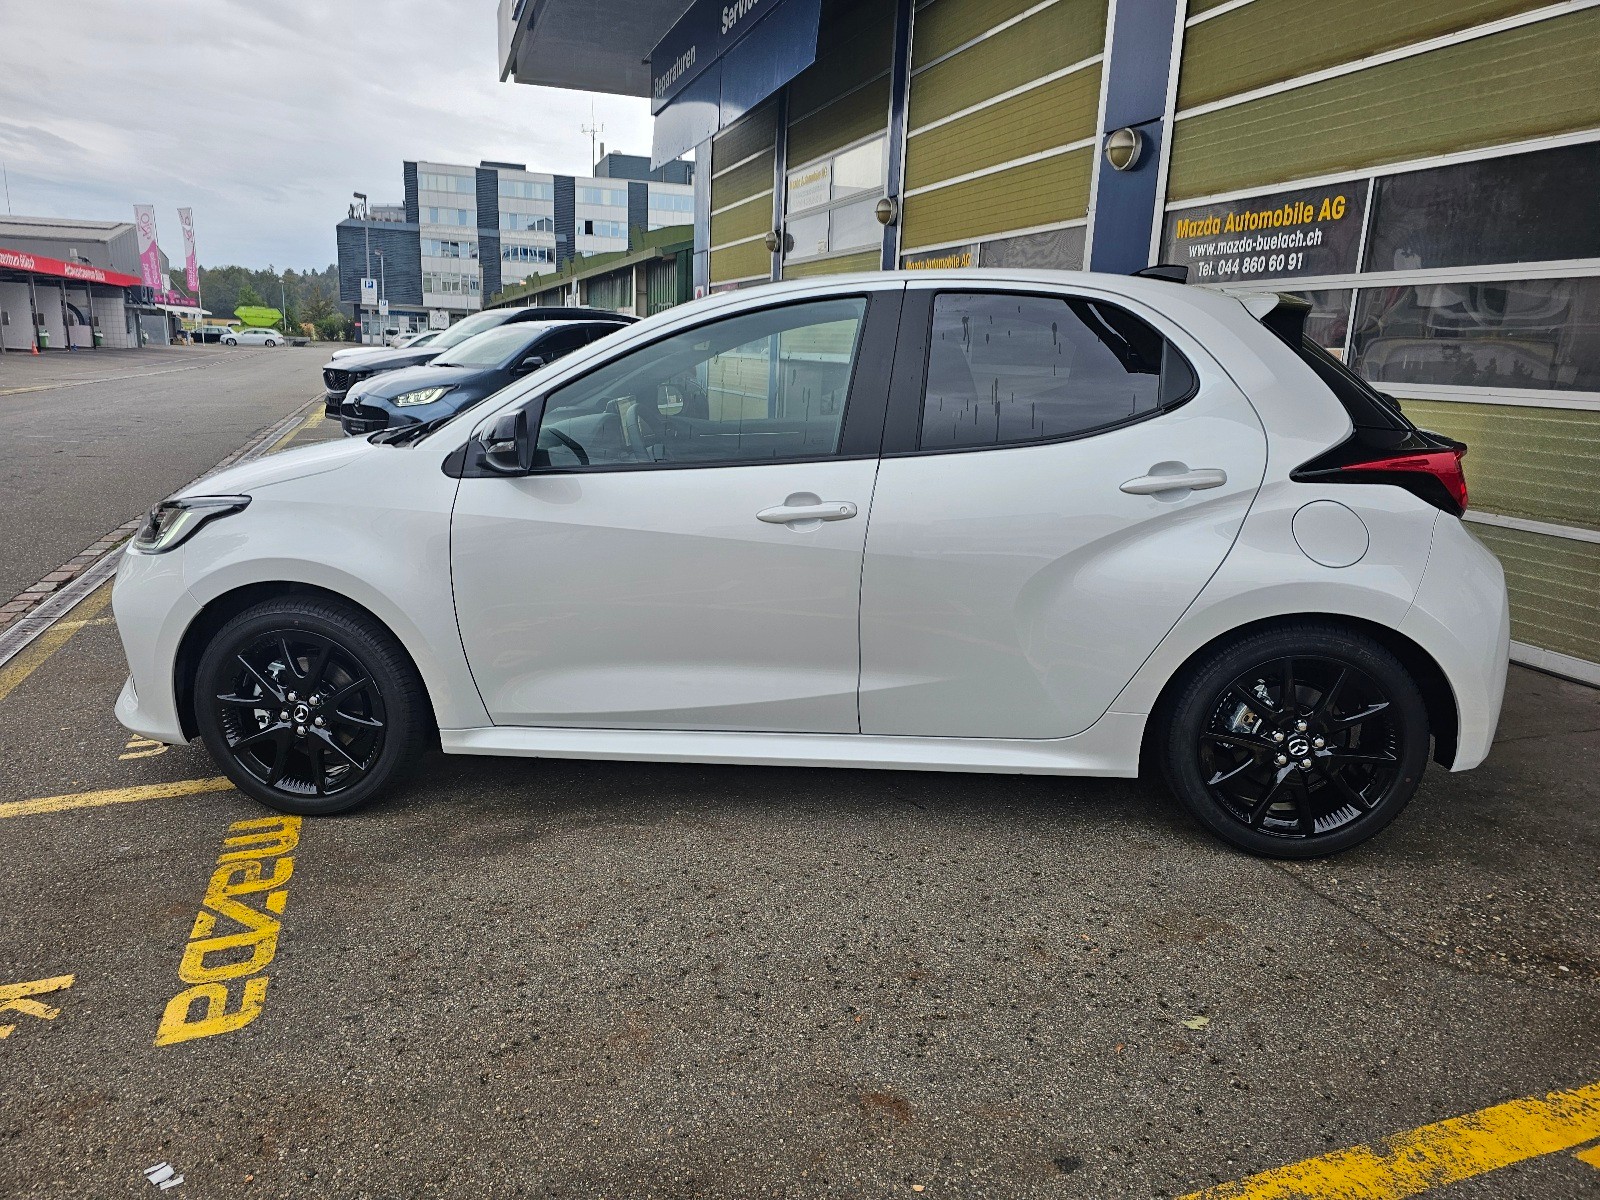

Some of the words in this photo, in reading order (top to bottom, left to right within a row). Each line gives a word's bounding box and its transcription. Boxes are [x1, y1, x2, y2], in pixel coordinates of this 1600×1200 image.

[721, 0, 759, 34] Servic
[654, 45, 696, 98] Reparaturen
[1176, 215, 1220, 239] Mazda
[1224, 201, 1314, 233] Automobile
[1318, 195, 1346, 221] AG
[1189, 228, 1322, 258] www.mazda-buelach.ch
[1198, 260, 1215, 277] Tel.
[1218, 258, 1239, 276] 044
[1242, 255, 1266, 273] 860
[1268, 254, 1285, 272] 60
[1288, 252, 1304, 270] 91
[153, 815, 303, 1047] mazda
